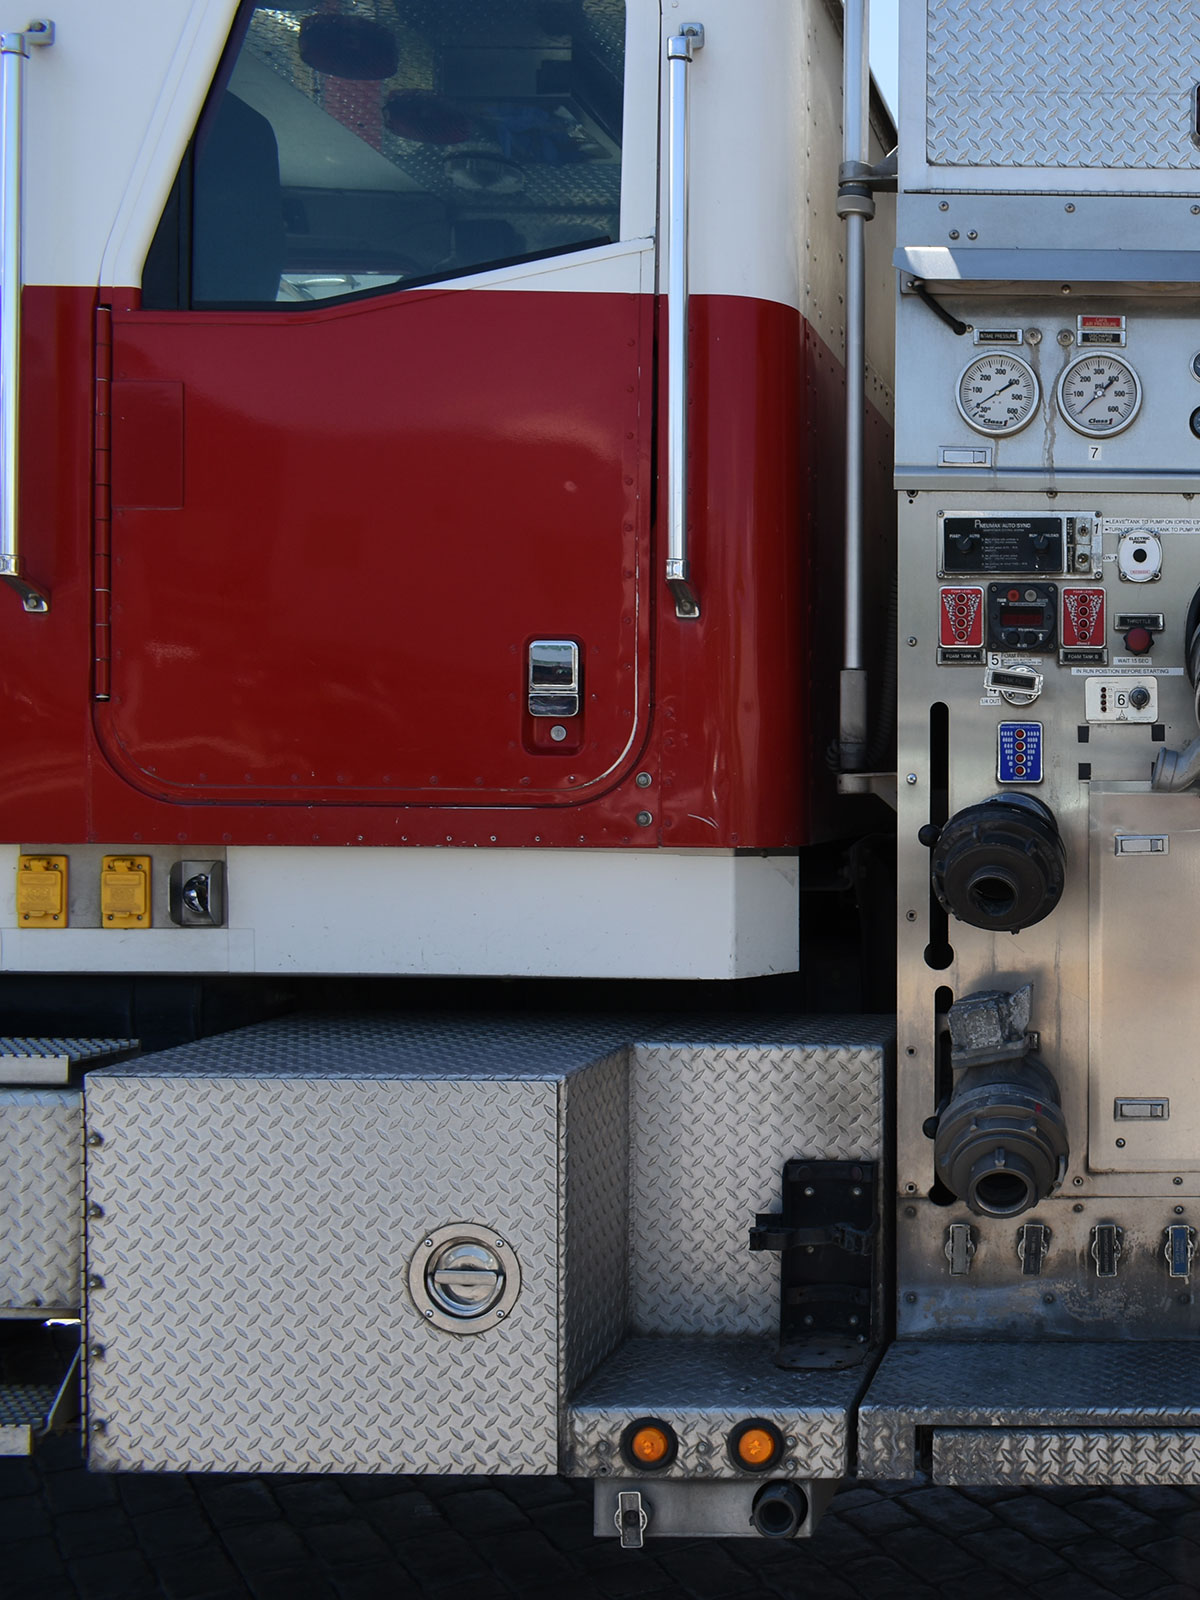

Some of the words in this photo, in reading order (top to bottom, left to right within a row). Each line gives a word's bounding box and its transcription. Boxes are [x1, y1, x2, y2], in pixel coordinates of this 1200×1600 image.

[1091, 447, 1098, 458] 7
[1094, 523, 1099, 534] 1
[991, 654, 999, 665] 5
[1118, 694, 1125, 705] 6
